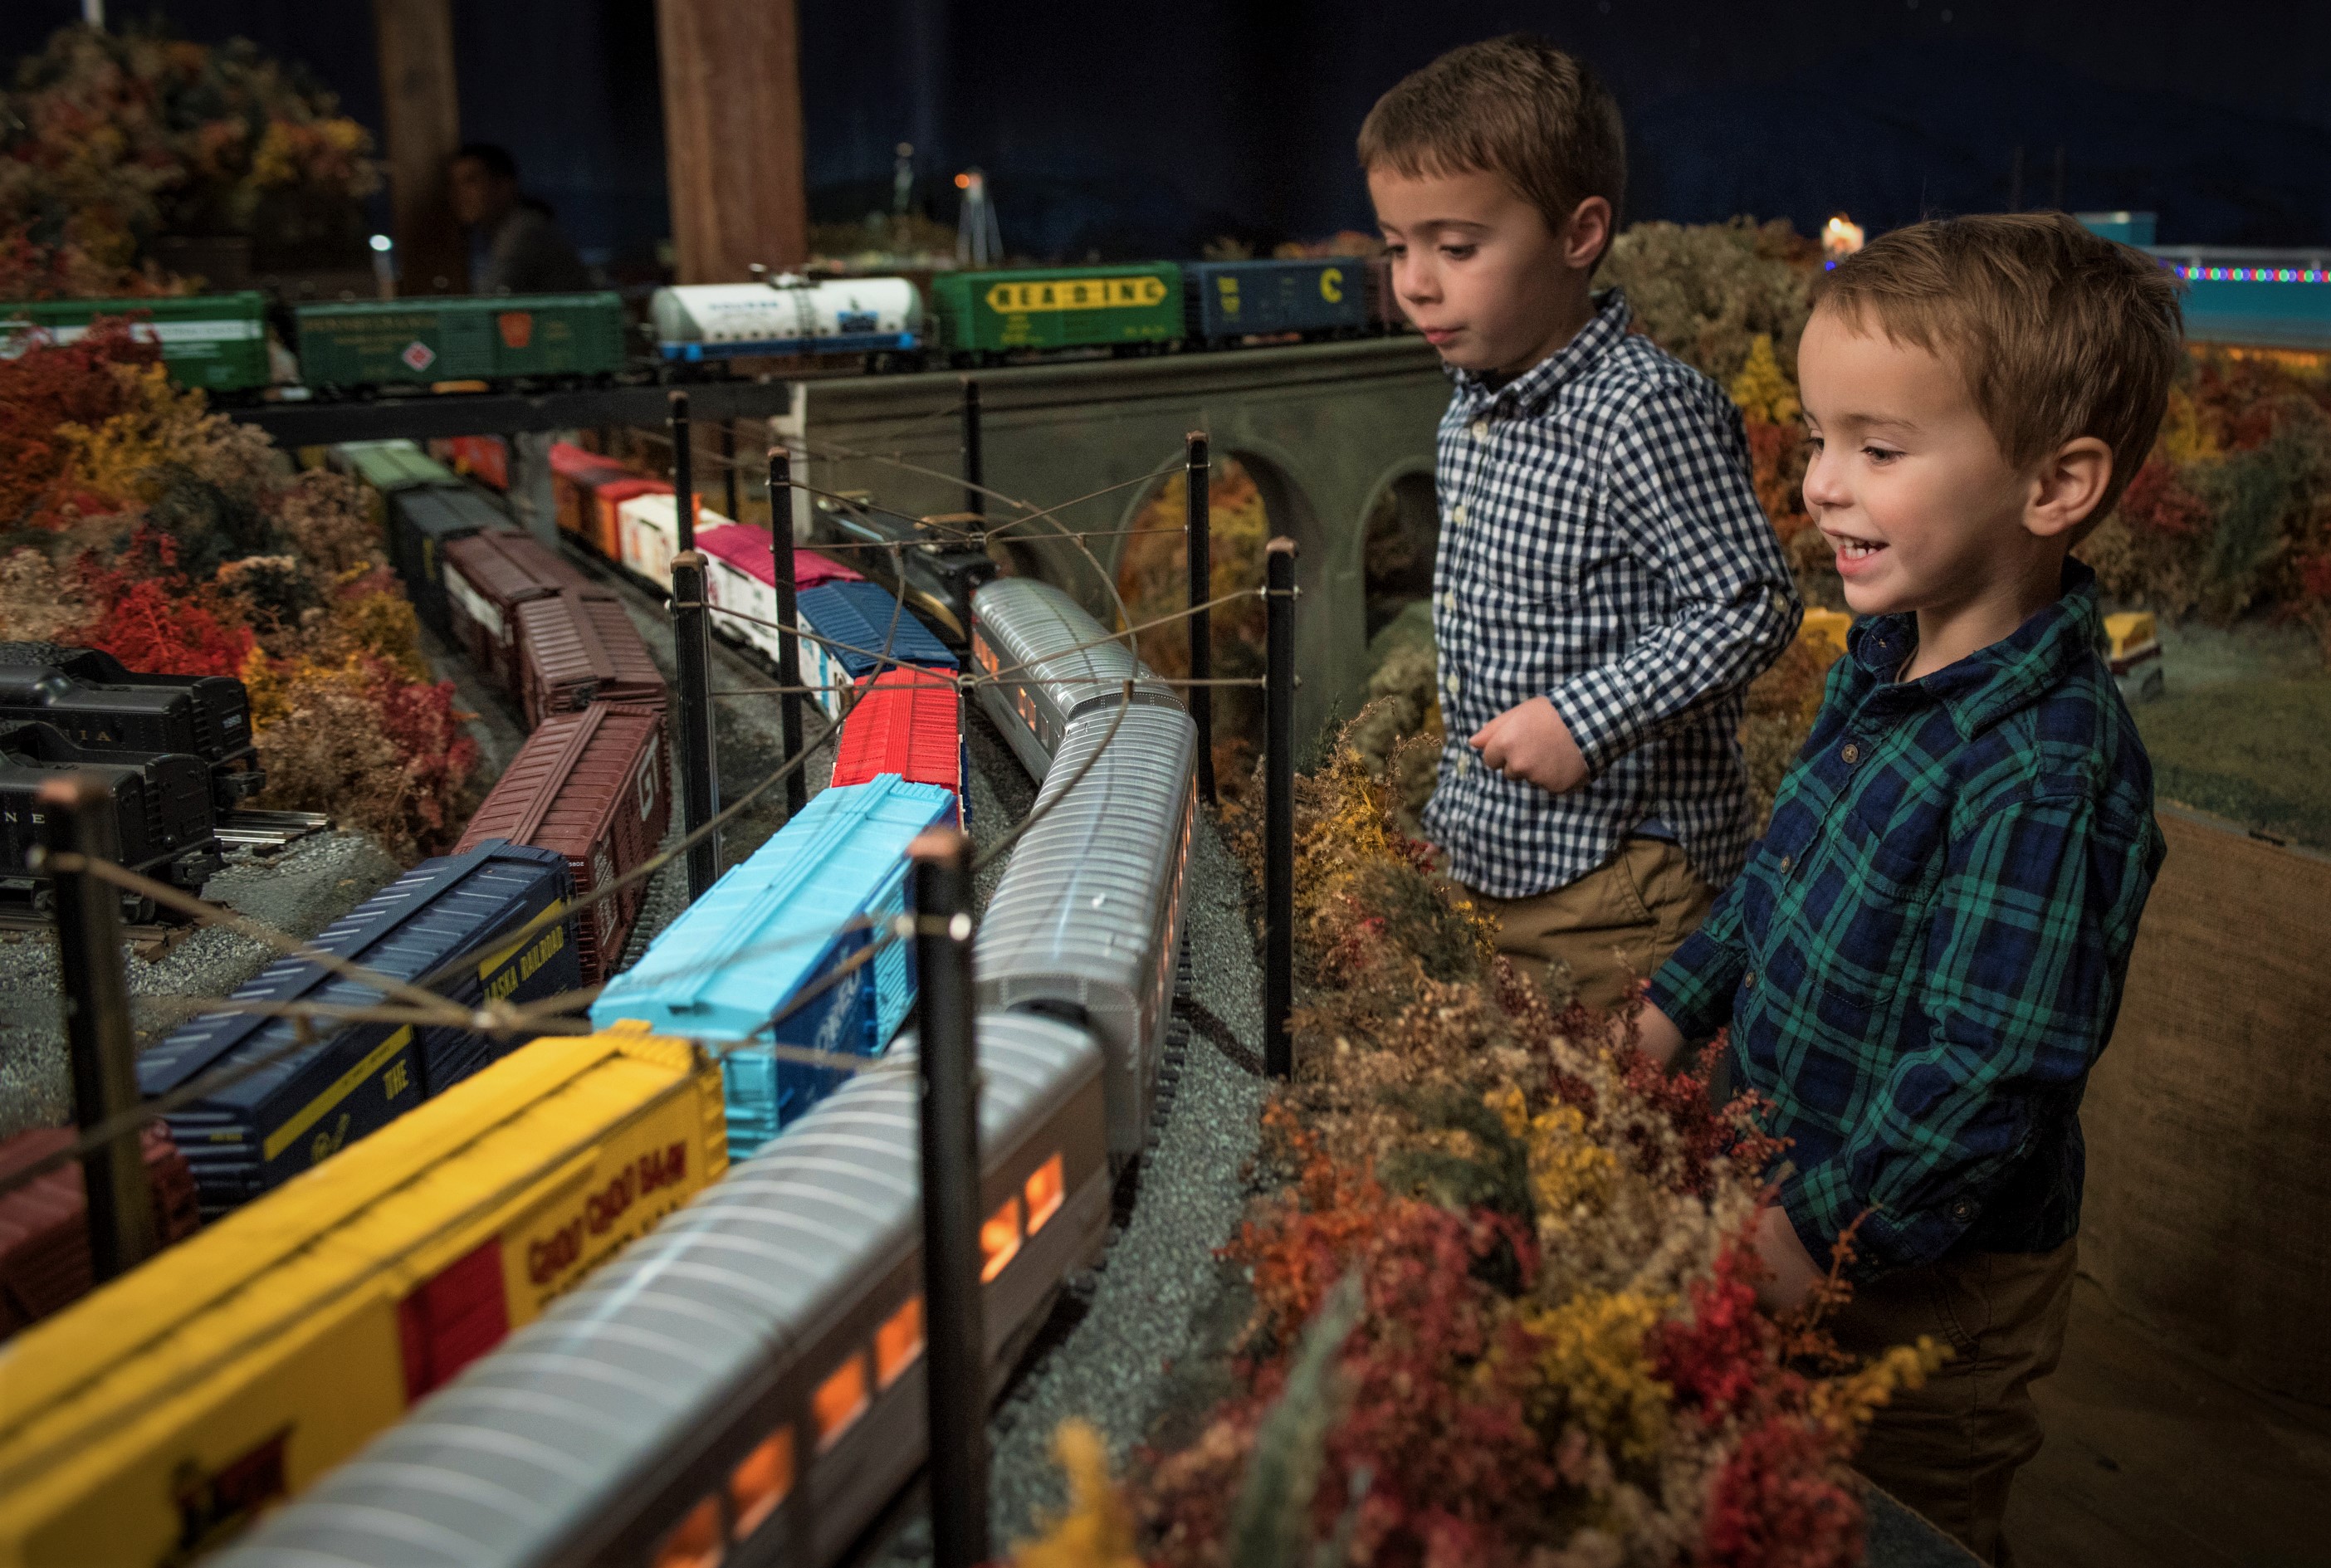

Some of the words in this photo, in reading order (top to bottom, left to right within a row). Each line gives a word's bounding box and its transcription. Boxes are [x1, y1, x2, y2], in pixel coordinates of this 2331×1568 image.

[996, 282, 1161, 306] READING
[384, 1058, 408, 1101] THE
[520, 925, 564, 983] RAILROAD
